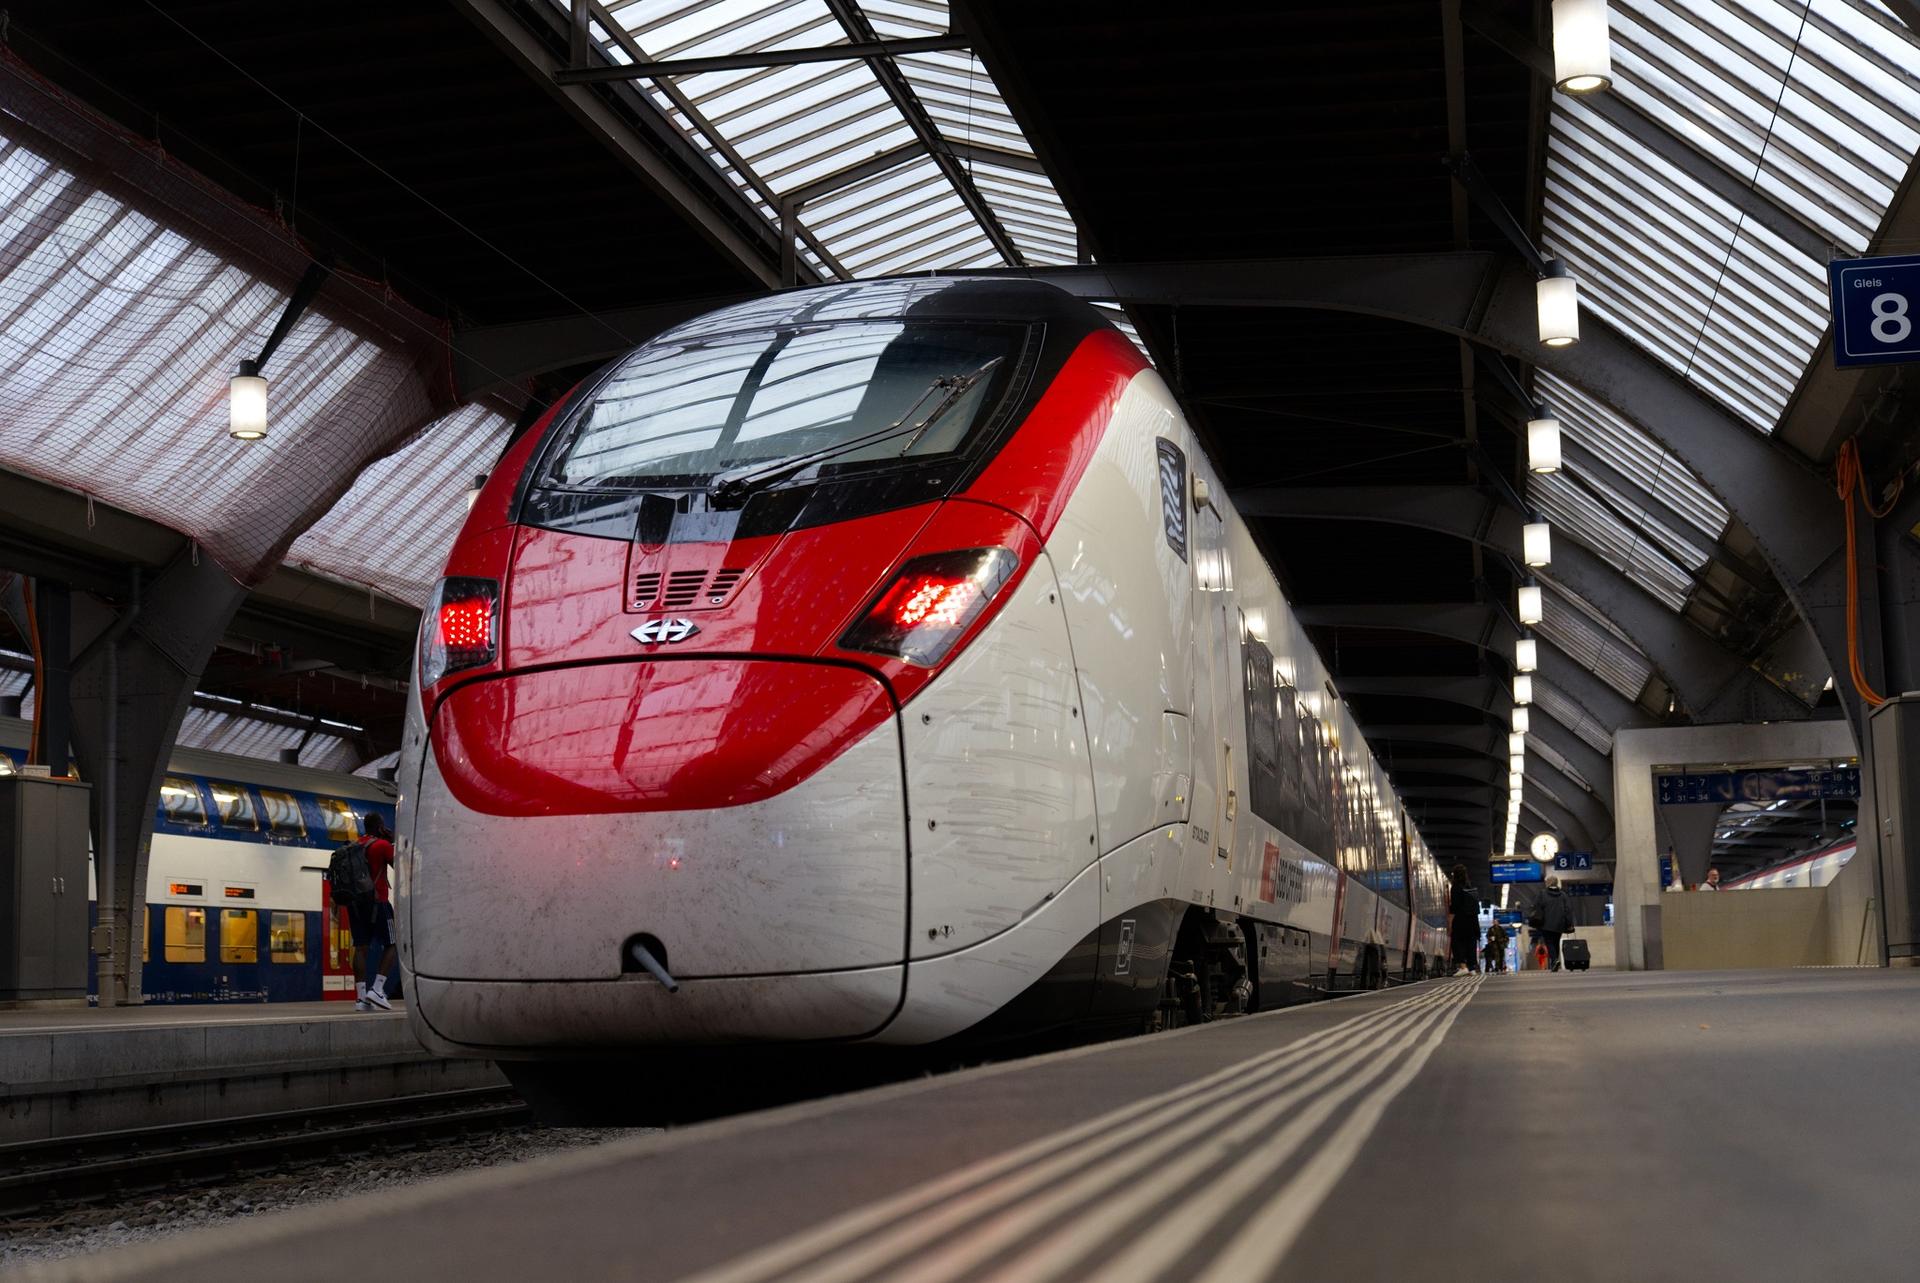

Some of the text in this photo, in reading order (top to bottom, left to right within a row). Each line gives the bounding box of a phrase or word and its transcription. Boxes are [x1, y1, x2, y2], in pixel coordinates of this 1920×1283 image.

[1853, 278, 1882, 288] Gleis
[1870, 292, 1912, 344] 8
[1678, 779, 1684, 787] 3
[1699, 779, 1706, 787] 7
[1559, 858, 1568, 867] 8
[1578, 857, 1587, 867] A
